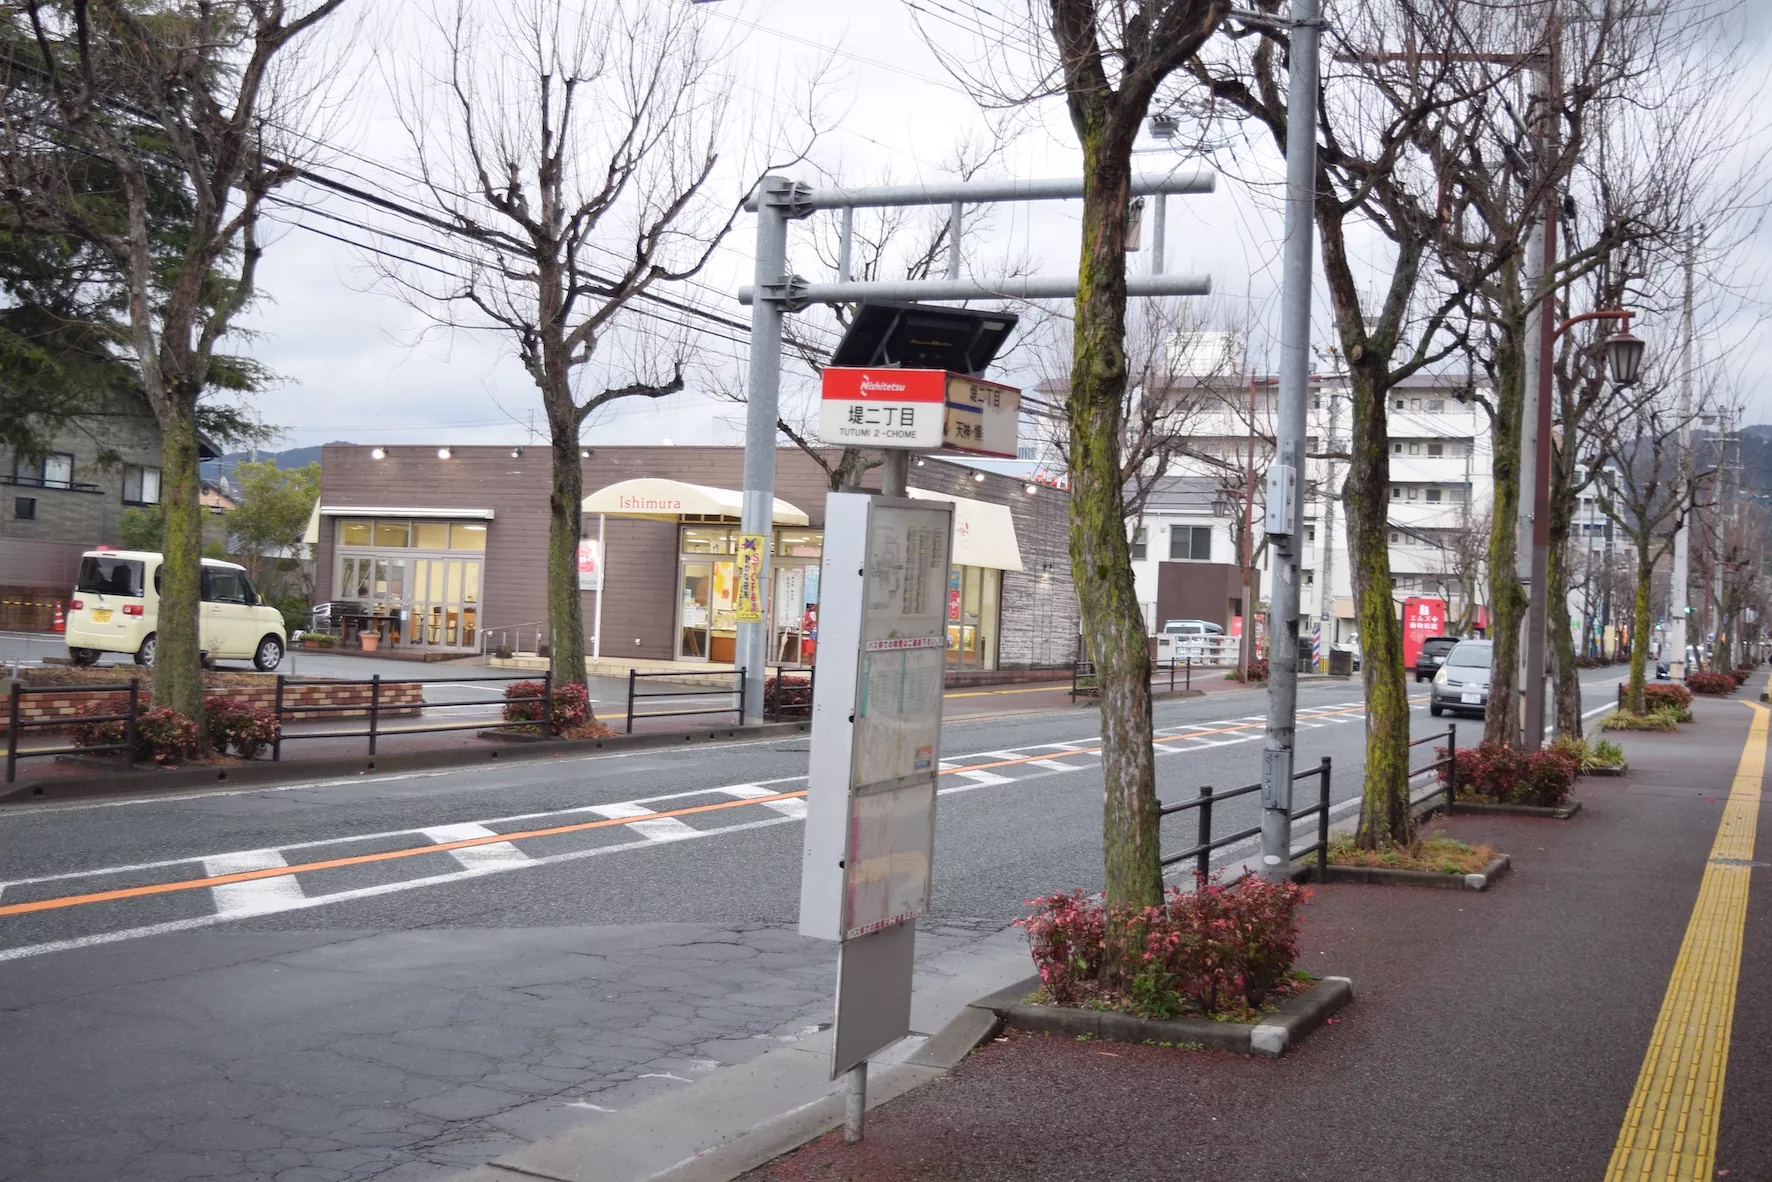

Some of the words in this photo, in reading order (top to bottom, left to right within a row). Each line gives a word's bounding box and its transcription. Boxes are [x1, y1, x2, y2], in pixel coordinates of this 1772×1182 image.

[860, 379, 906, 393] Nishitetsu
[970, 384, 1000, 408] 堤二丁目
[848, 405, 914, 427] 堤二丁目
[840, 428, 871, 437] TUTUMI
[620, 495, 681, 509] Ishimura
